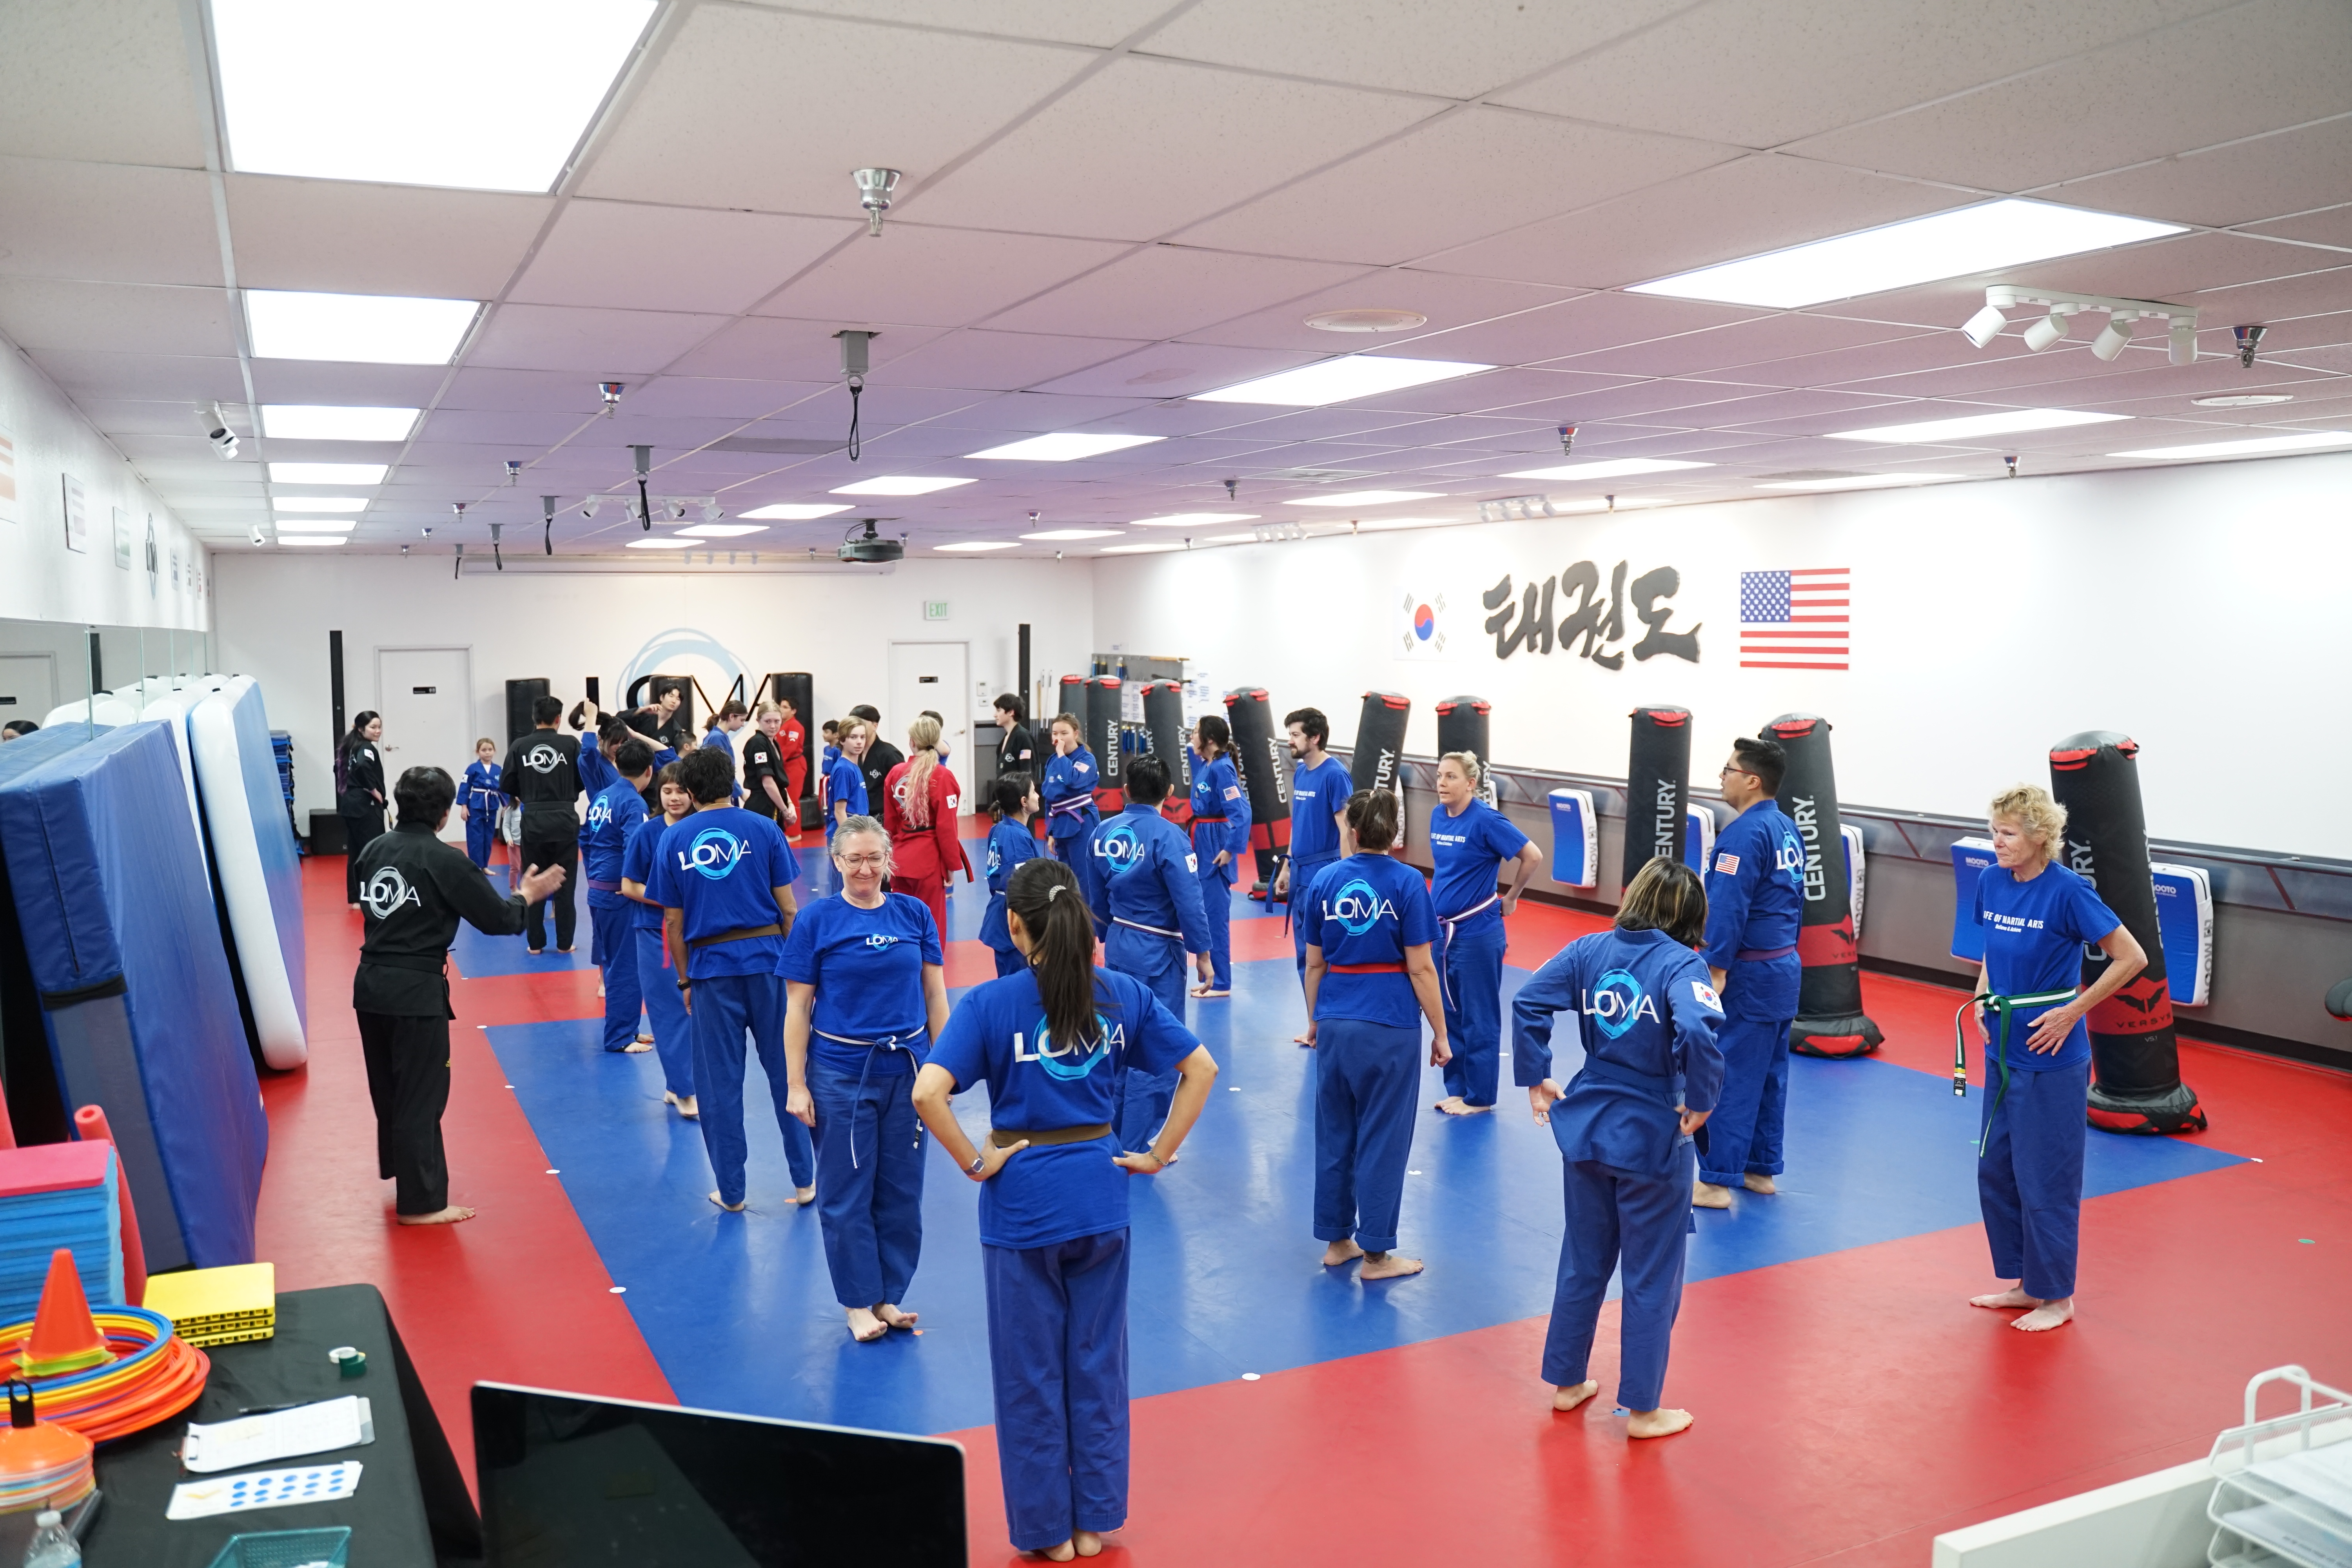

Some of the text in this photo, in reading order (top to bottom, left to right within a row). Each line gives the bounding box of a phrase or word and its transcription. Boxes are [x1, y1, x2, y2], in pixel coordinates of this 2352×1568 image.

[929, 603, 947, 617] EXIT
[1483, 559, 1702, 671] 태권도
[522, 752, 567, 767] LOMA
[1107, 720, 1118, 776] CENTURY
[1177, 725, 1191, 785] CENTURY
[1267, 737, 1287, 804] CENTURY
[1374, 748, 1395, 789] TURY
[1655, 779, 1676, 858] ENTURY
[677, 839, 751, 871] LOMA
[1094, 838, 1144, 862] LOMA
[359, 881, 421, 907] LOMA
[2154, 884, 2176, 895] OOTO
[1322, 898, 1399, 920] LOMA
[1984, 911, 2044, 929] IFE OF MARTIAL ARTS
[866, 936, 898, 945] LOMA
[1582, 989, 1661, 1024] LOMA
[2116, 1013, 2171, 1028] VERSYS
[1014, 1023, 1125, 1063] LOMA
